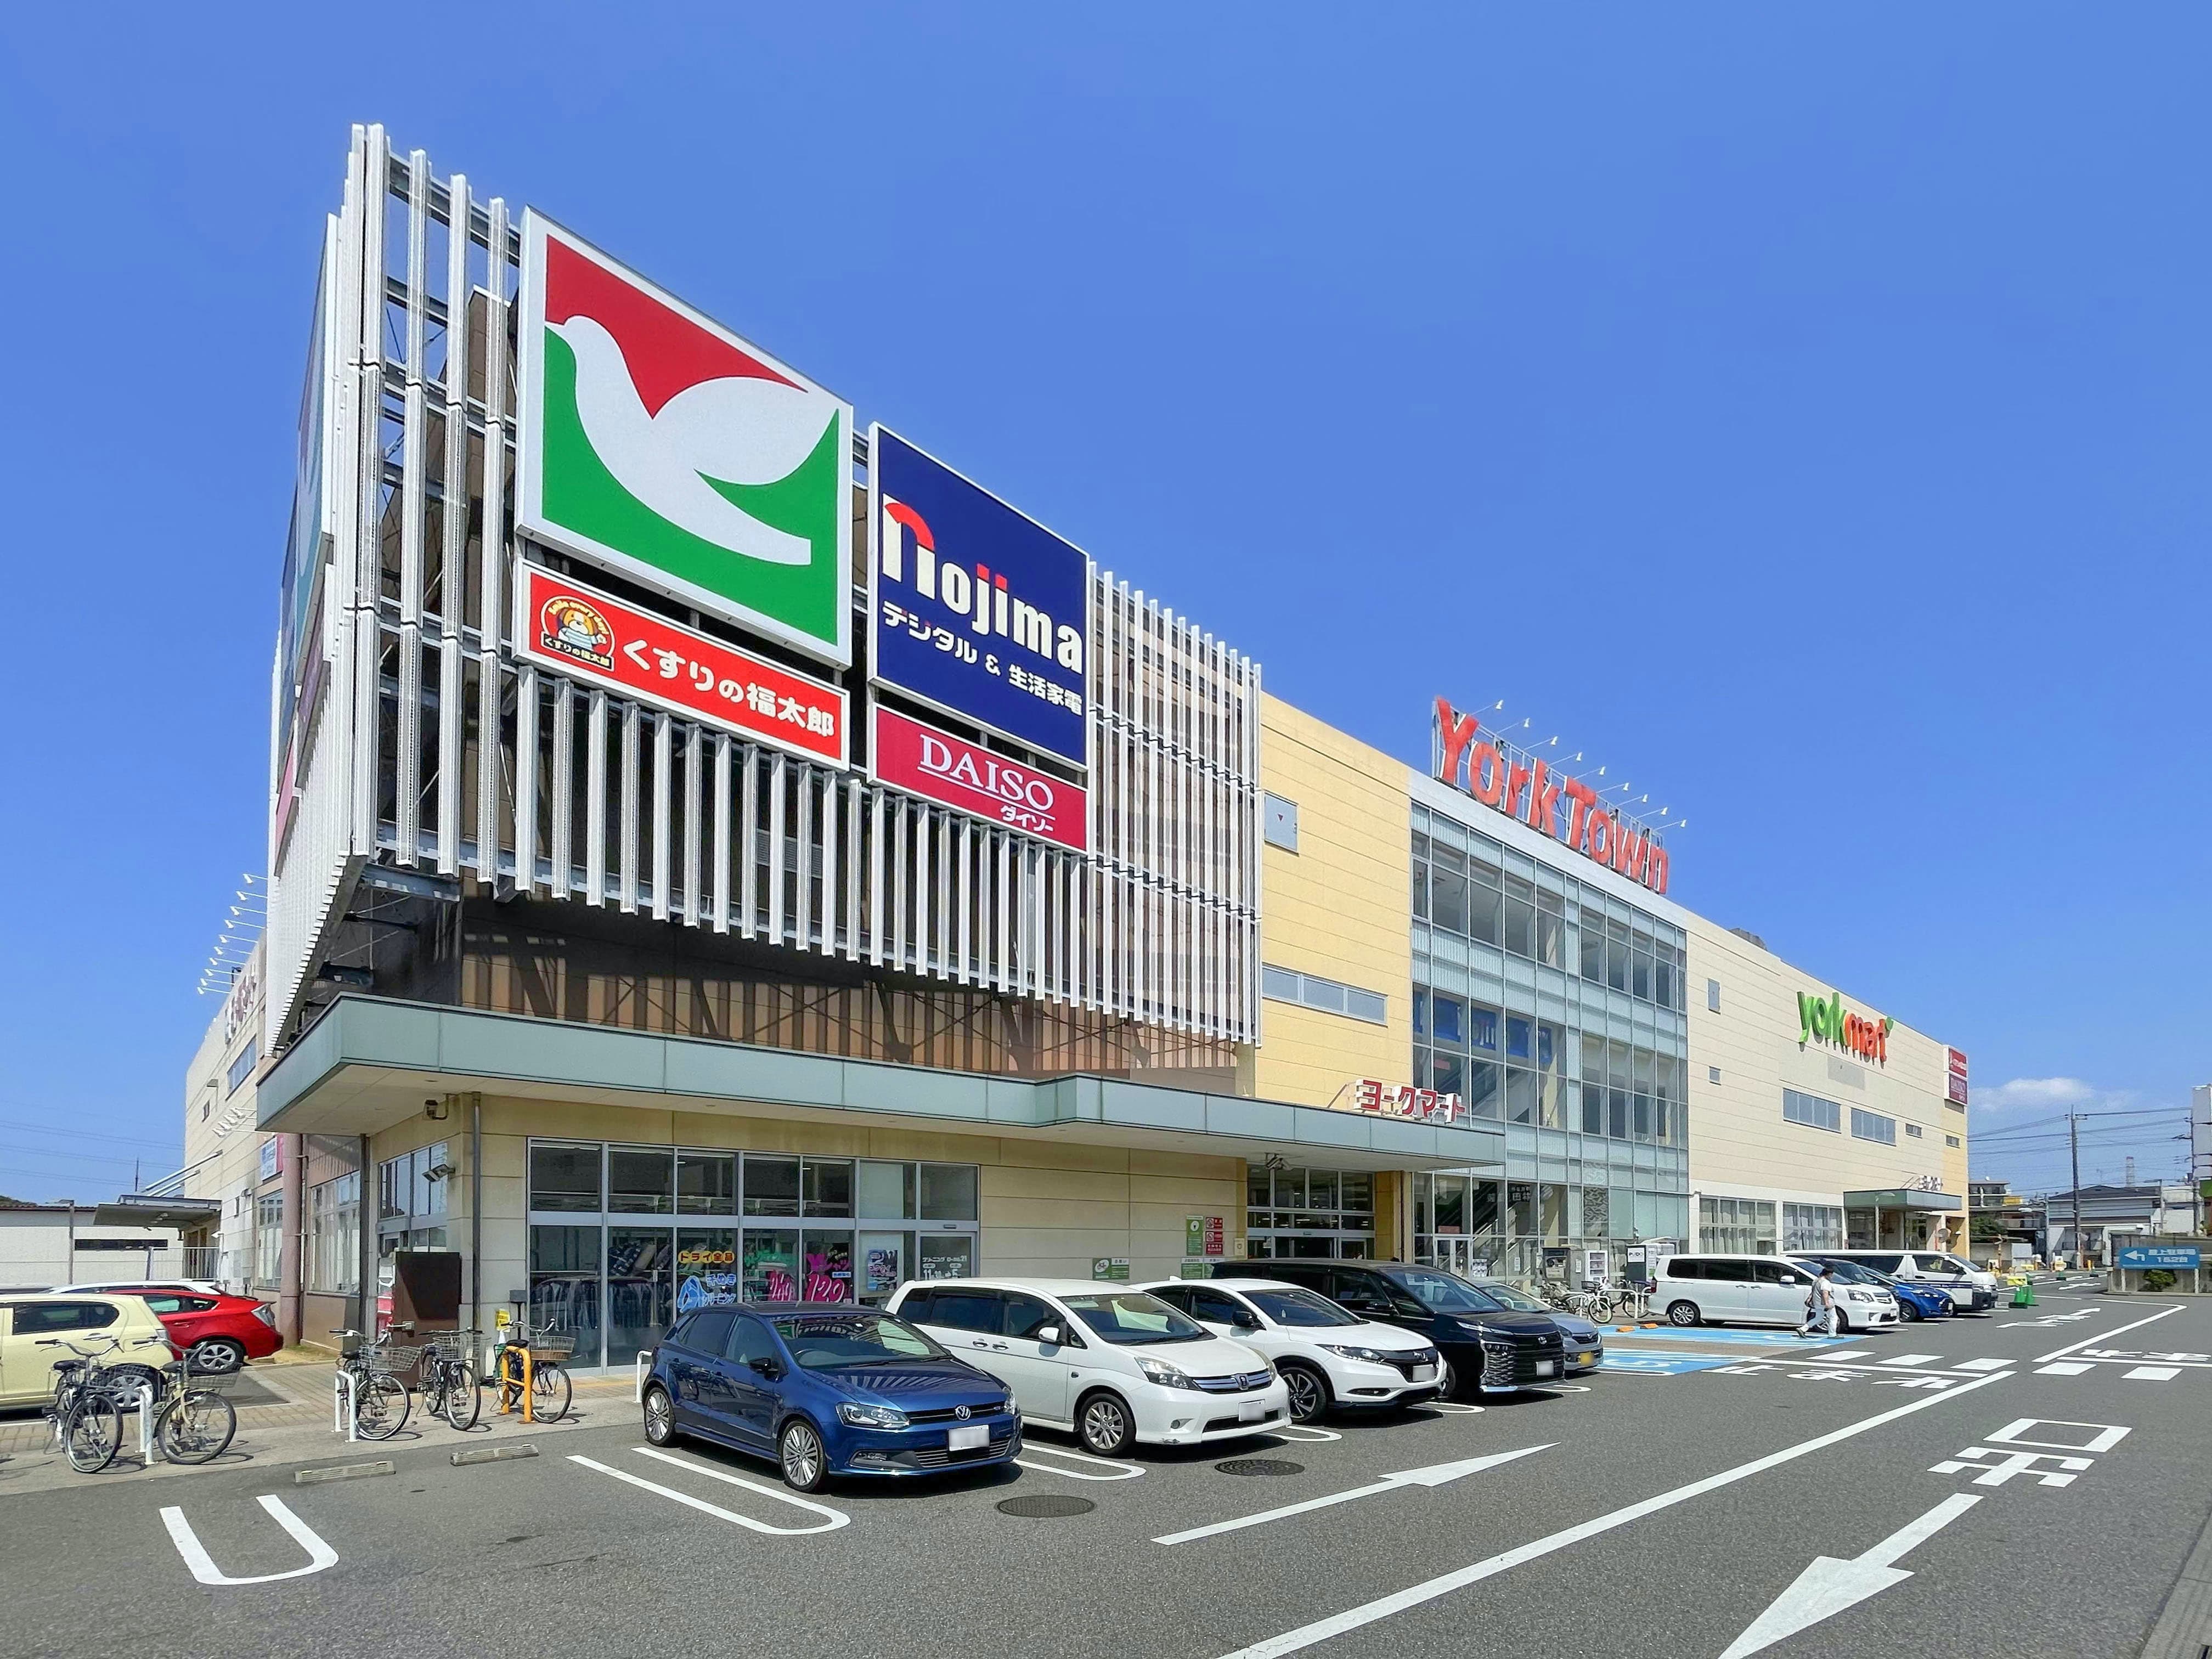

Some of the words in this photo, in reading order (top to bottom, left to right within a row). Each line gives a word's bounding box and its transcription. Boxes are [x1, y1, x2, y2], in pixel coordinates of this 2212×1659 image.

[883, 493, 1083, 675] nojima
[623, 639, 835, 737] くすりの福太郎
[883, 601, 978, 664] デジタル
[985, 654, 1001, 676] &
[1008, 663, 1082, 716] 生活家電
[919, 733, 1054, 811] DAISO
[1000, 805, 1054, 833] ダイソー
[1354, 1079, 1466, 1124] ヨークマート
